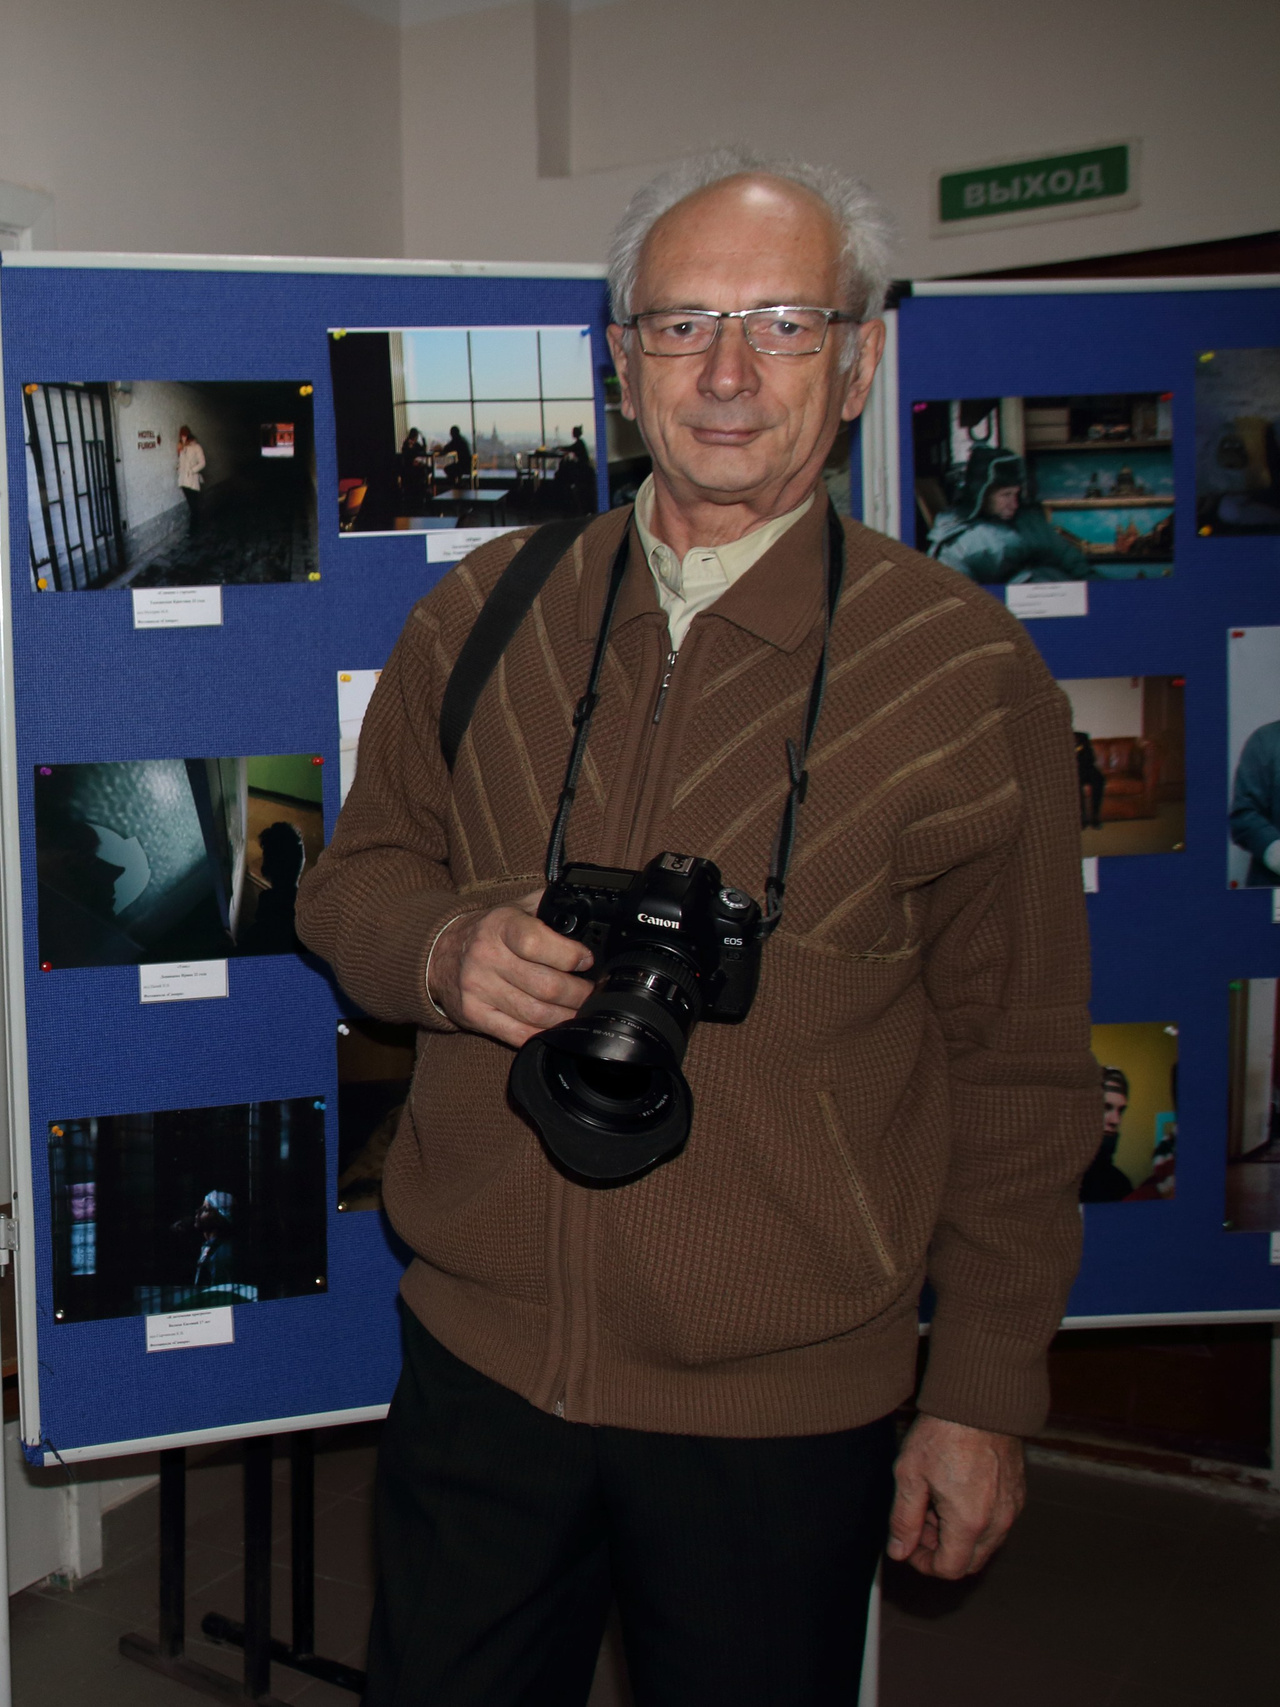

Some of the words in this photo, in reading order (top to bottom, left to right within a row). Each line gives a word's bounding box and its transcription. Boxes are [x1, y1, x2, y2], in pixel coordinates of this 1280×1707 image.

[963, 163, 1104, 209] ВЫХОД
[637, 913, 680, 930] Canon
[723, 937, 743, 946] EOS
